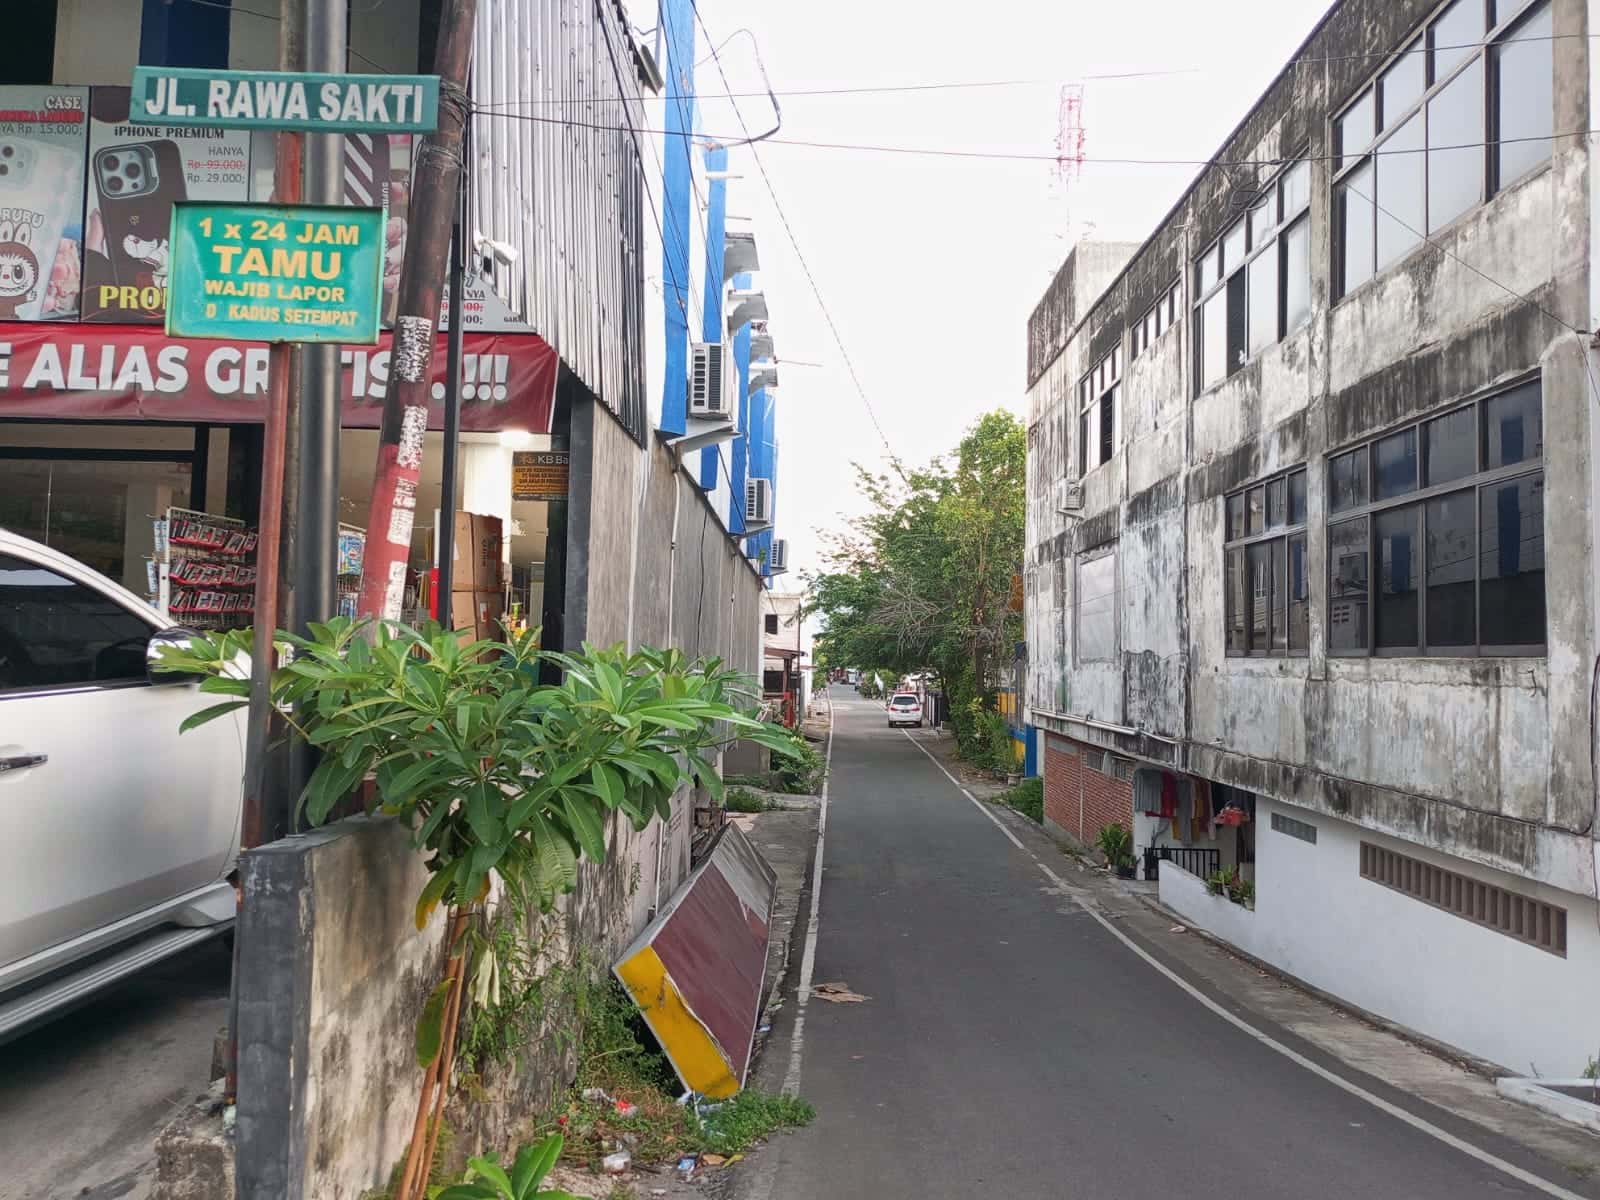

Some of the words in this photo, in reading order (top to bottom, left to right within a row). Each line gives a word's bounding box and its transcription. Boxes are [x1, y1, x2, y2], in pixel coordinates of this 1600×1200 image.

[45, 96, 81, 110] CASE
[145, 77, 196, 116] JL.
[207, 80, 309, 120] RAWA
[319, 83, 423, 123] SAKTI
[0, 124, 14, 134] YA
[166, 127, 224, 139] PREMIUM
[208, 146, 244, 156] HANYA
[200, 217, 213, 238] 1
[251, 220, 287, 241] 24
[296, 223, 360, 245] JAM
[212, 245, 341, 280] TAMU
[99, 285, 168, 310] PRO
[205, 279, 270, 298] WAJIB
[276, 282, 345, 303] LAPOR
[284, 308, 358, 326] SETEMPAT
[23, 344, 190, 394] ALIAS
